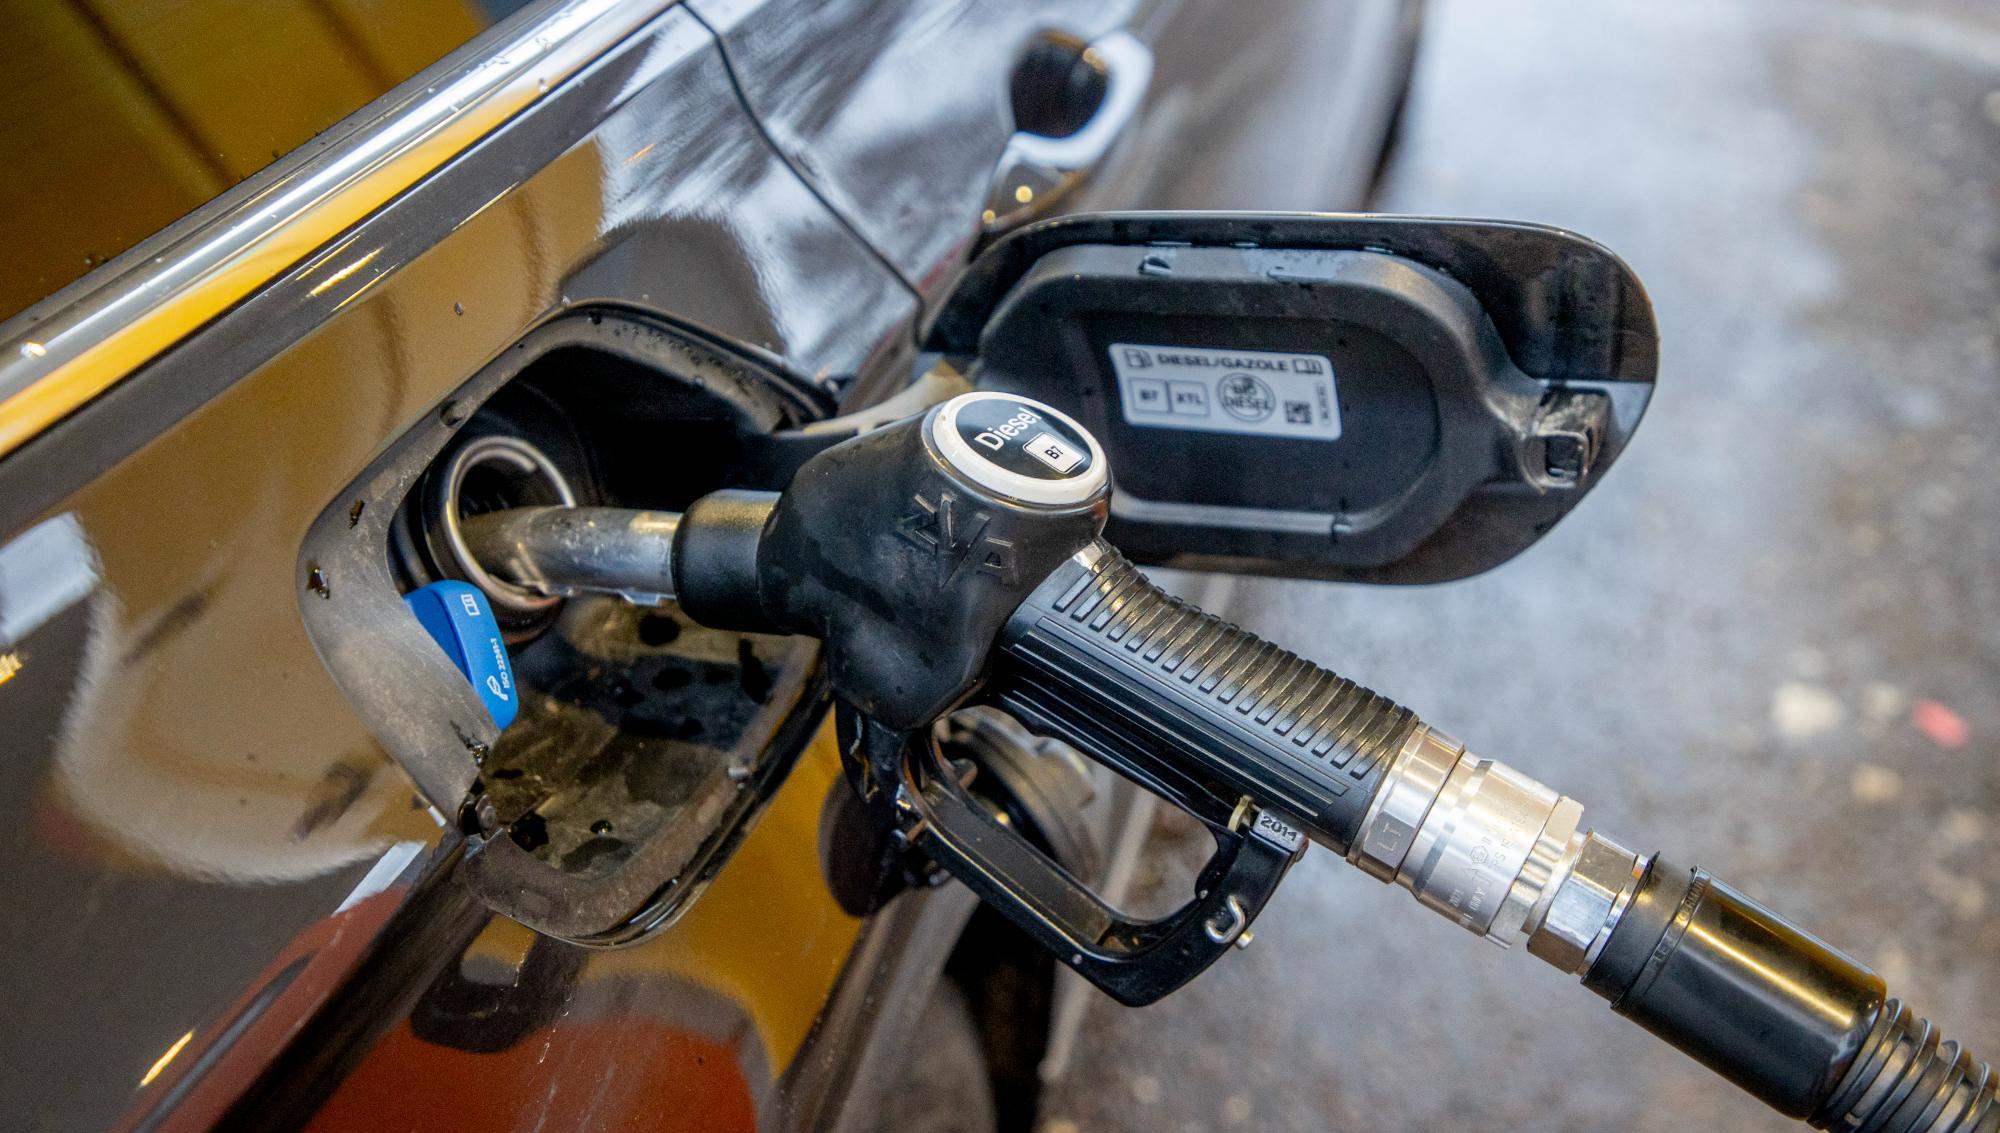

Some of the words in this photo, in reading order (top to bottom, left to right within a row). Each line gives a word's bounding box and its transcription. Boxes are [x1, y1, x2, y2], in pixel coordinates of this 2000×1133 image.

[1157, 353, 1289, 371] DIESEL/GAZOLE
[1176, 391, 1203, 405] XTL
[1224, 395, 1271, 411] DIESEL
[974, 407, 1042, 451] Diesel
[1044, 445, 1064, 460] B7
[500, 670, 510, 689] ISO
